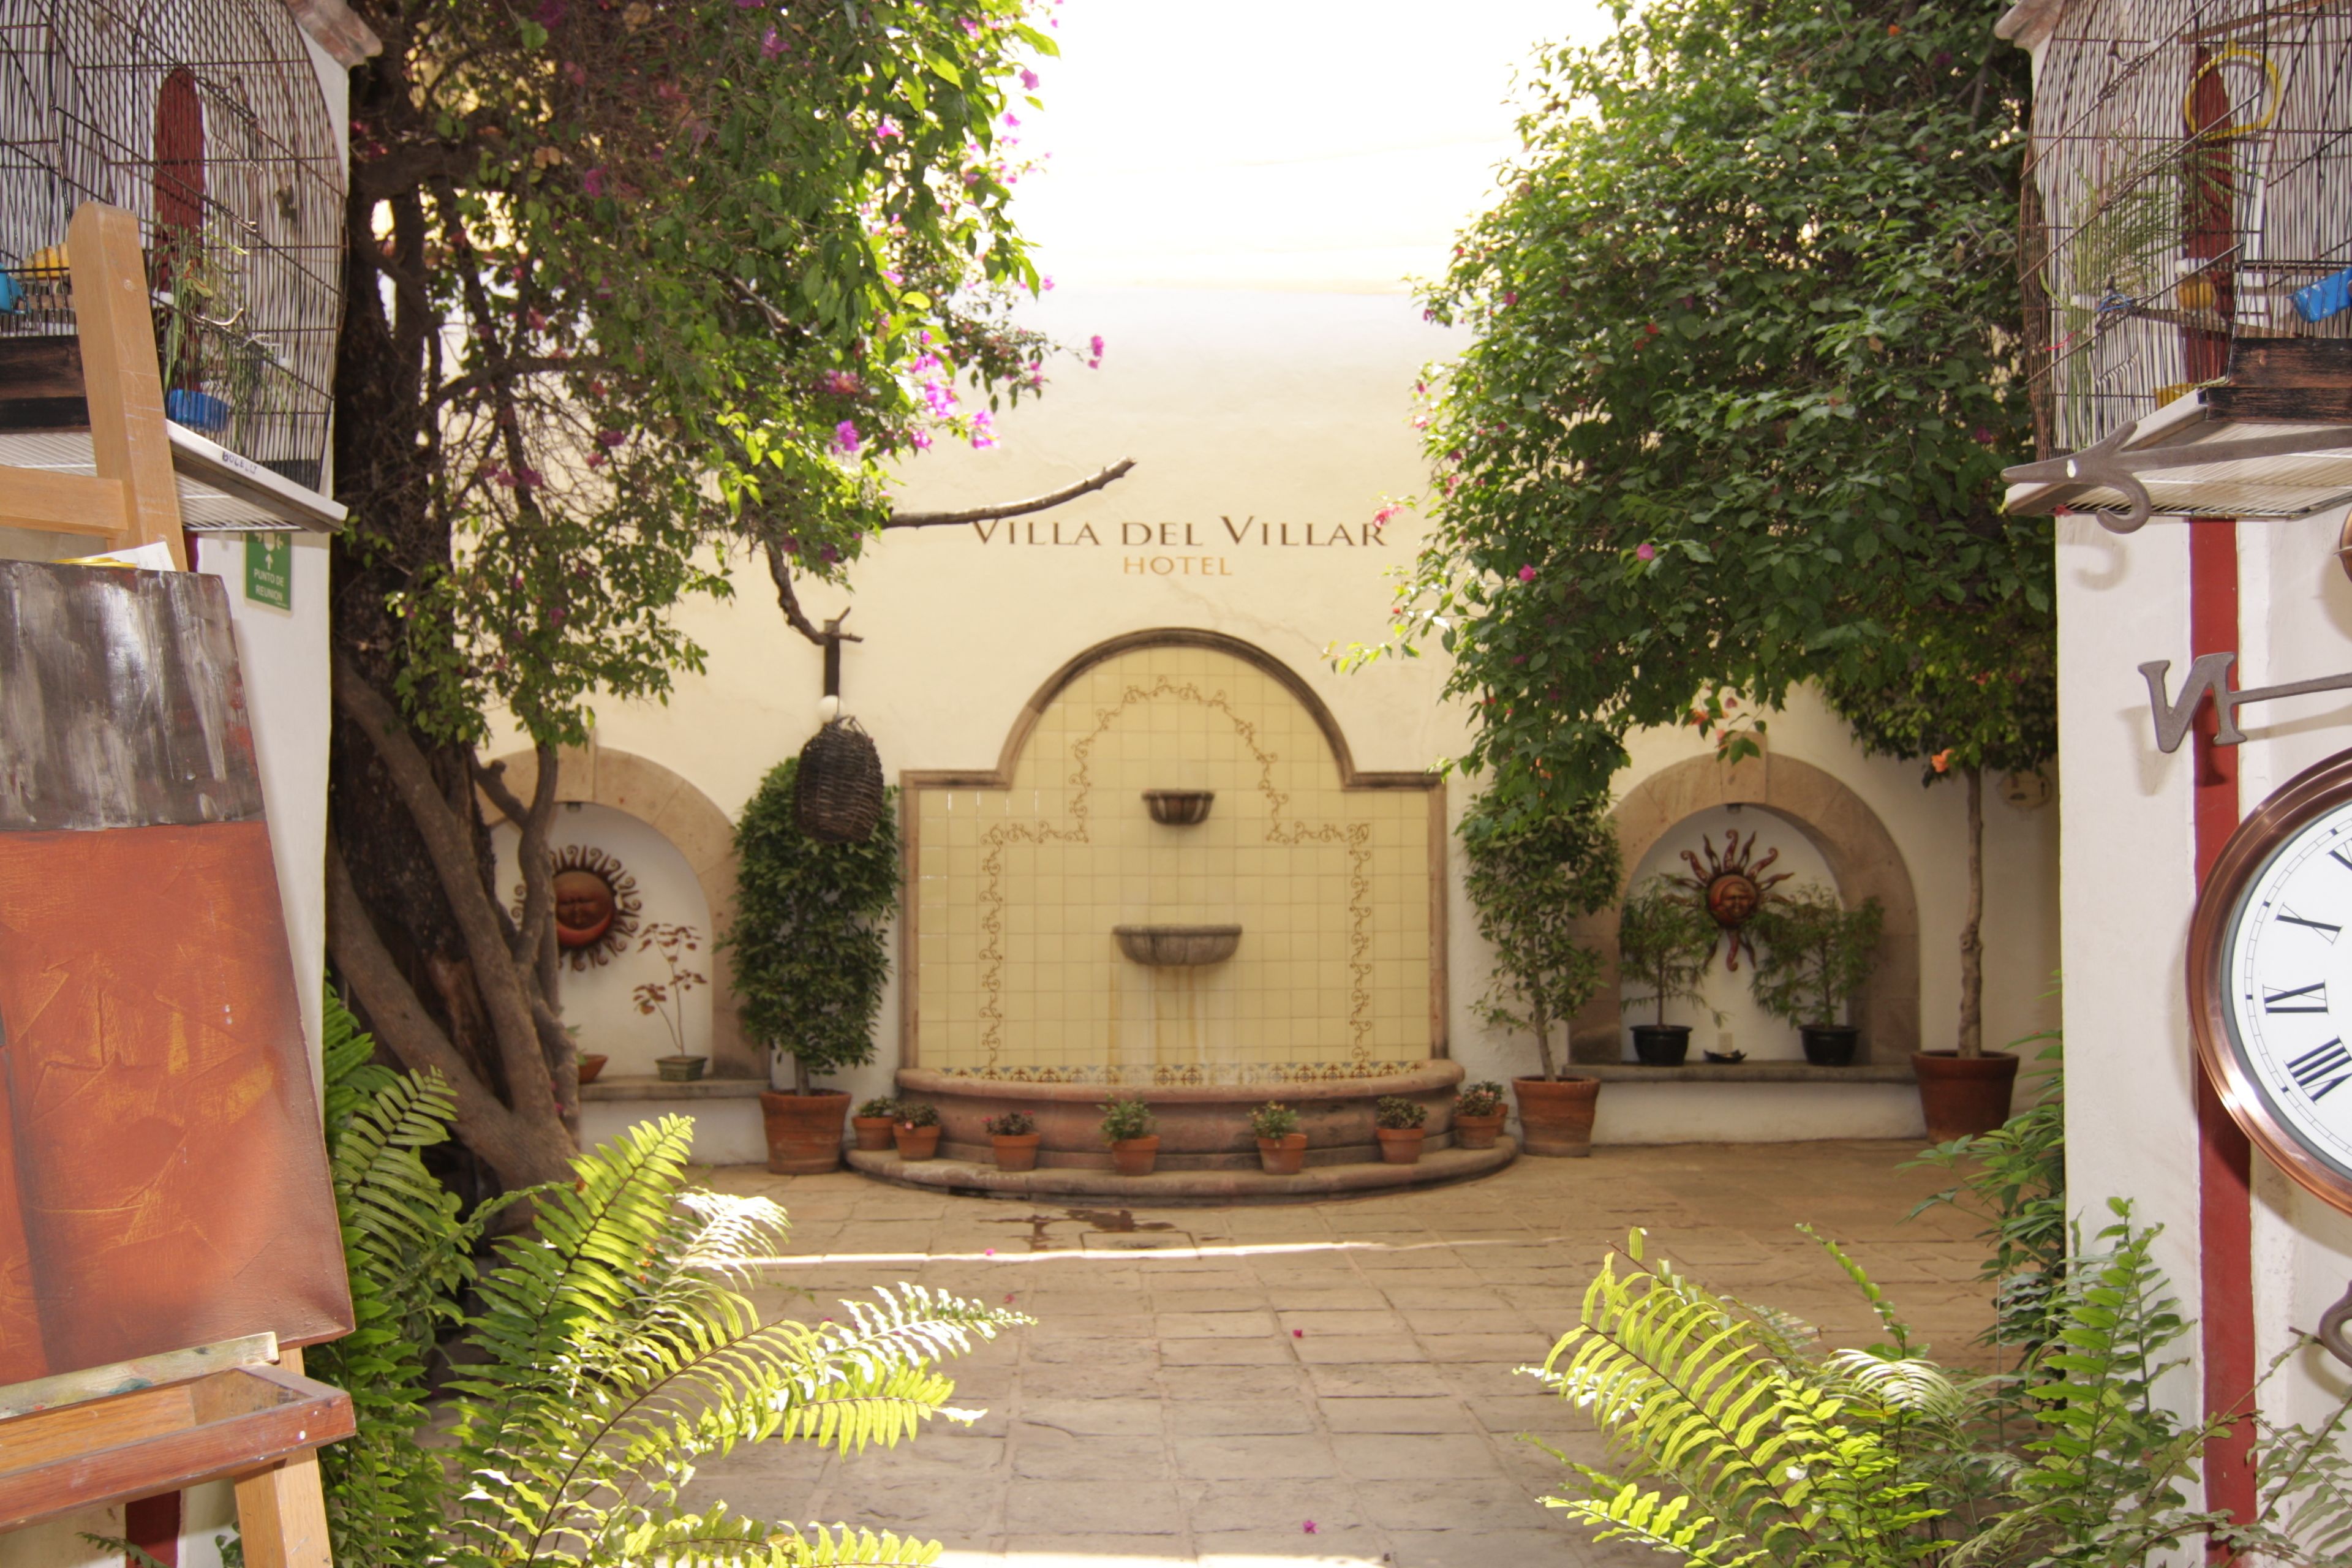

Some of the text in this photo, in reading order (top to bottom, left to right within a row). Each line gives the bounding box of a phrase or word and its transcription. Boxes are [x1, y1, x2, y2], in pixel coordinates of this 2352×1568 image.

[972, 515, 1389, 546] VILLA DEL VILLAR
[254, 567, 284, 587] PUNTO DE
[1123, 556, 1233, 576] HOTEL
[2274, 902, 2343, 946] X
[2263, 979, 2329, 1016] IX
[2283, 1035, 2352, 1106] VIII
